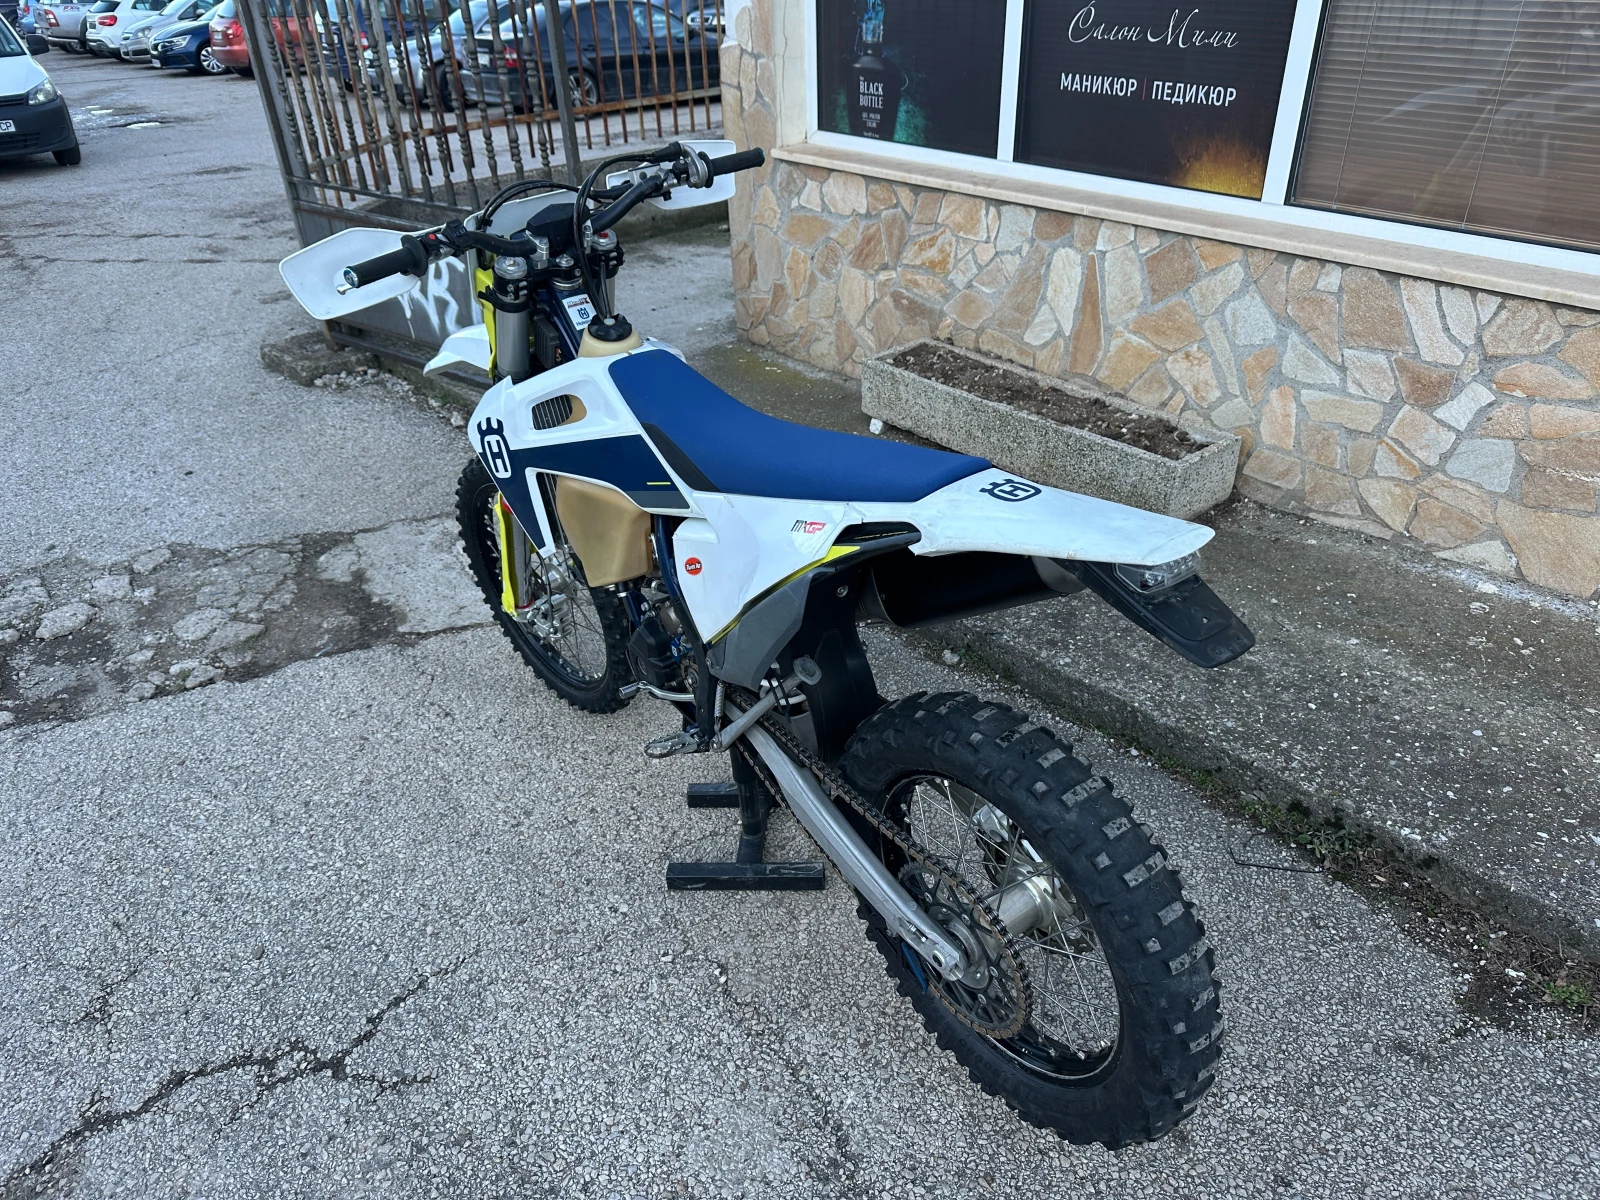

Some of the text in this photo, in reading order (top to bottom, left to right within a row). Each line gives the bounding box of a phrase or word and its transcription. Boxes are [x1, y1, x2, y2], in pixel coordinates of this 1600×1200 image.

[1068, 0, 1238, 48] Салон Мими
[859, 81, 883, 95] BLACK
[1060, 72, 1237, 107] МАНИКЮР ПЕДИКЮР
[859, 95, 883, 108] BOTTLE
